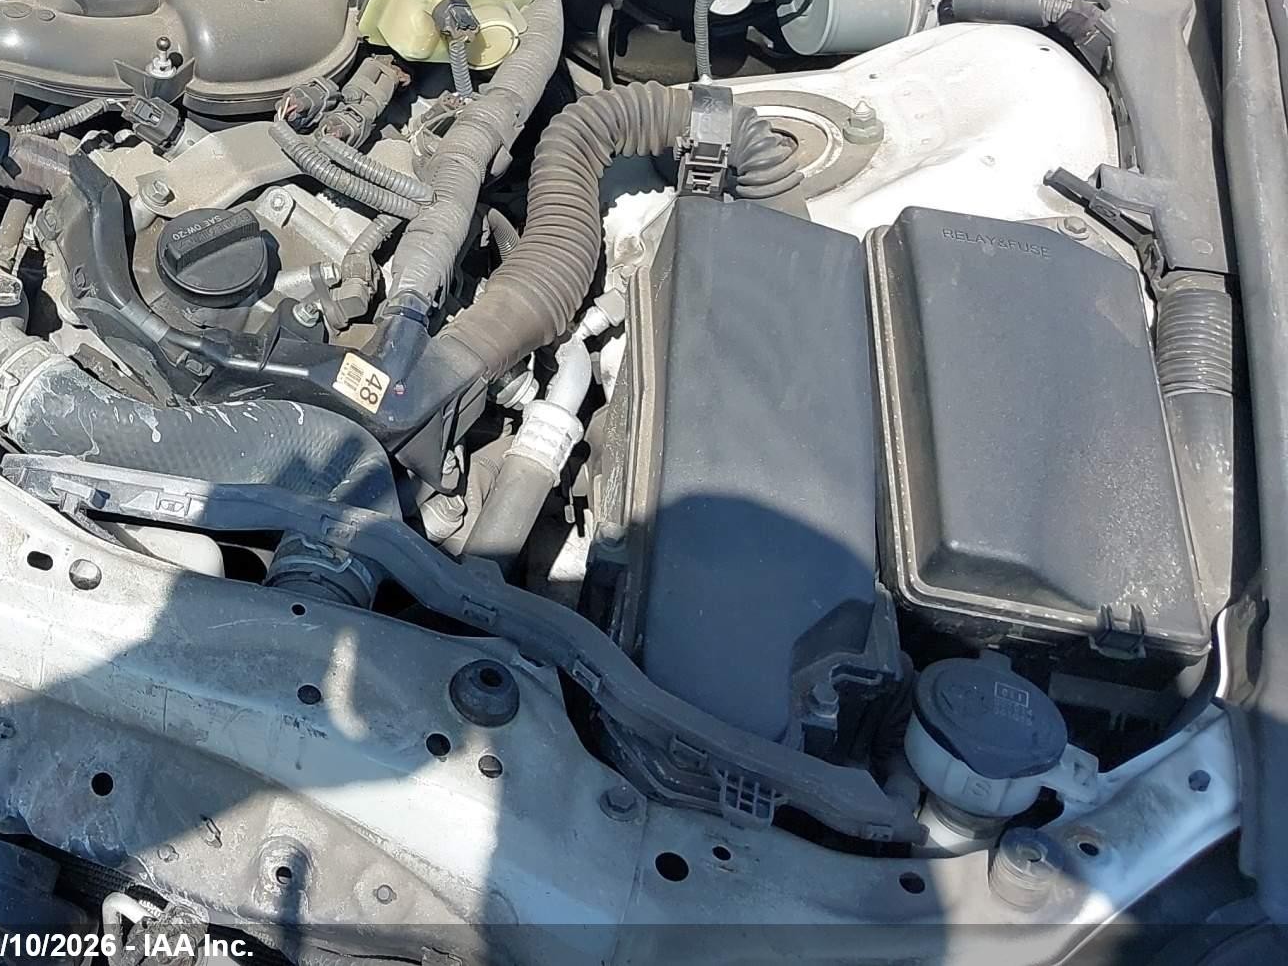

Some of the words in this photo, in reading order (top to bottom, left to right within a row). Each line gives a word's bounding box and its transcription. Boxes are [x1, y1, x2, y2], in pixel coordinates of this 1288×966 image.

[172, 223, 202, 241] 0W-20
[203, 215, 223, 227] SAE
[942, 228, 1050, 257] RELAY&FUSE
[359, 373, 383, 405] 48
